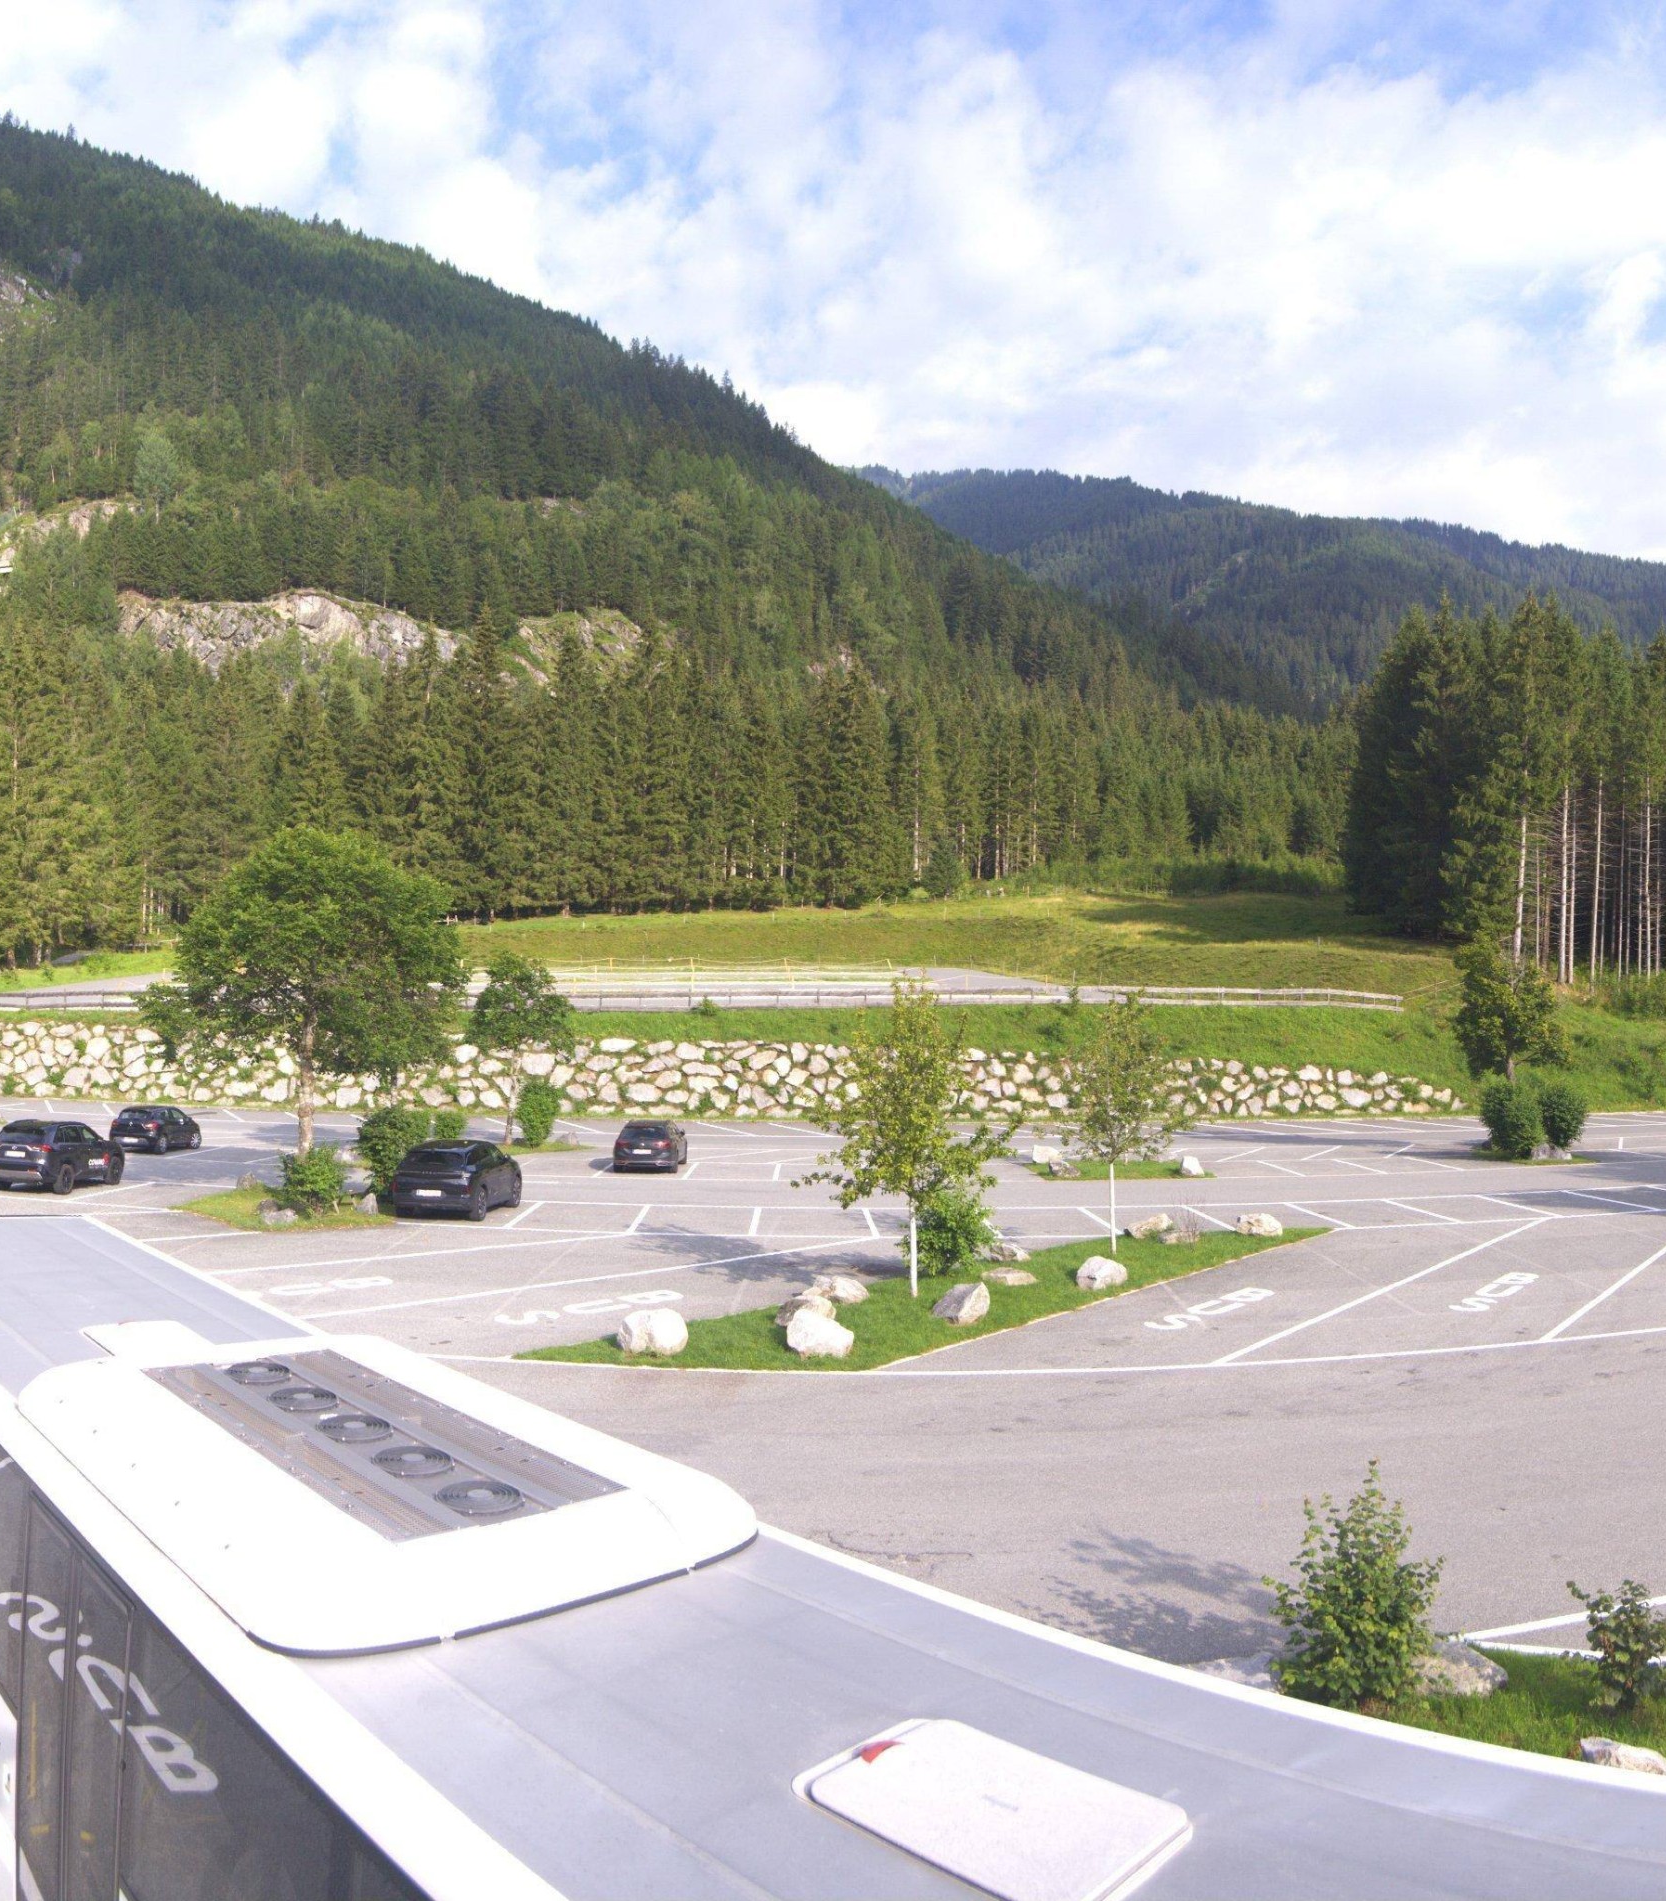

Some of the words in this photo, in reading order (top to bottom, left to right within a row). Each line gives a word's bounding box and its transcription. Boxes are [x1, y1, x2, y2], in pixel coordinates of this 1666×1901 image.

[494, 1290, 685, 1326] BUS
[1144, 1286, 1275, 1331] BUS
[1449, 1271, 1540, 1312] BUS
